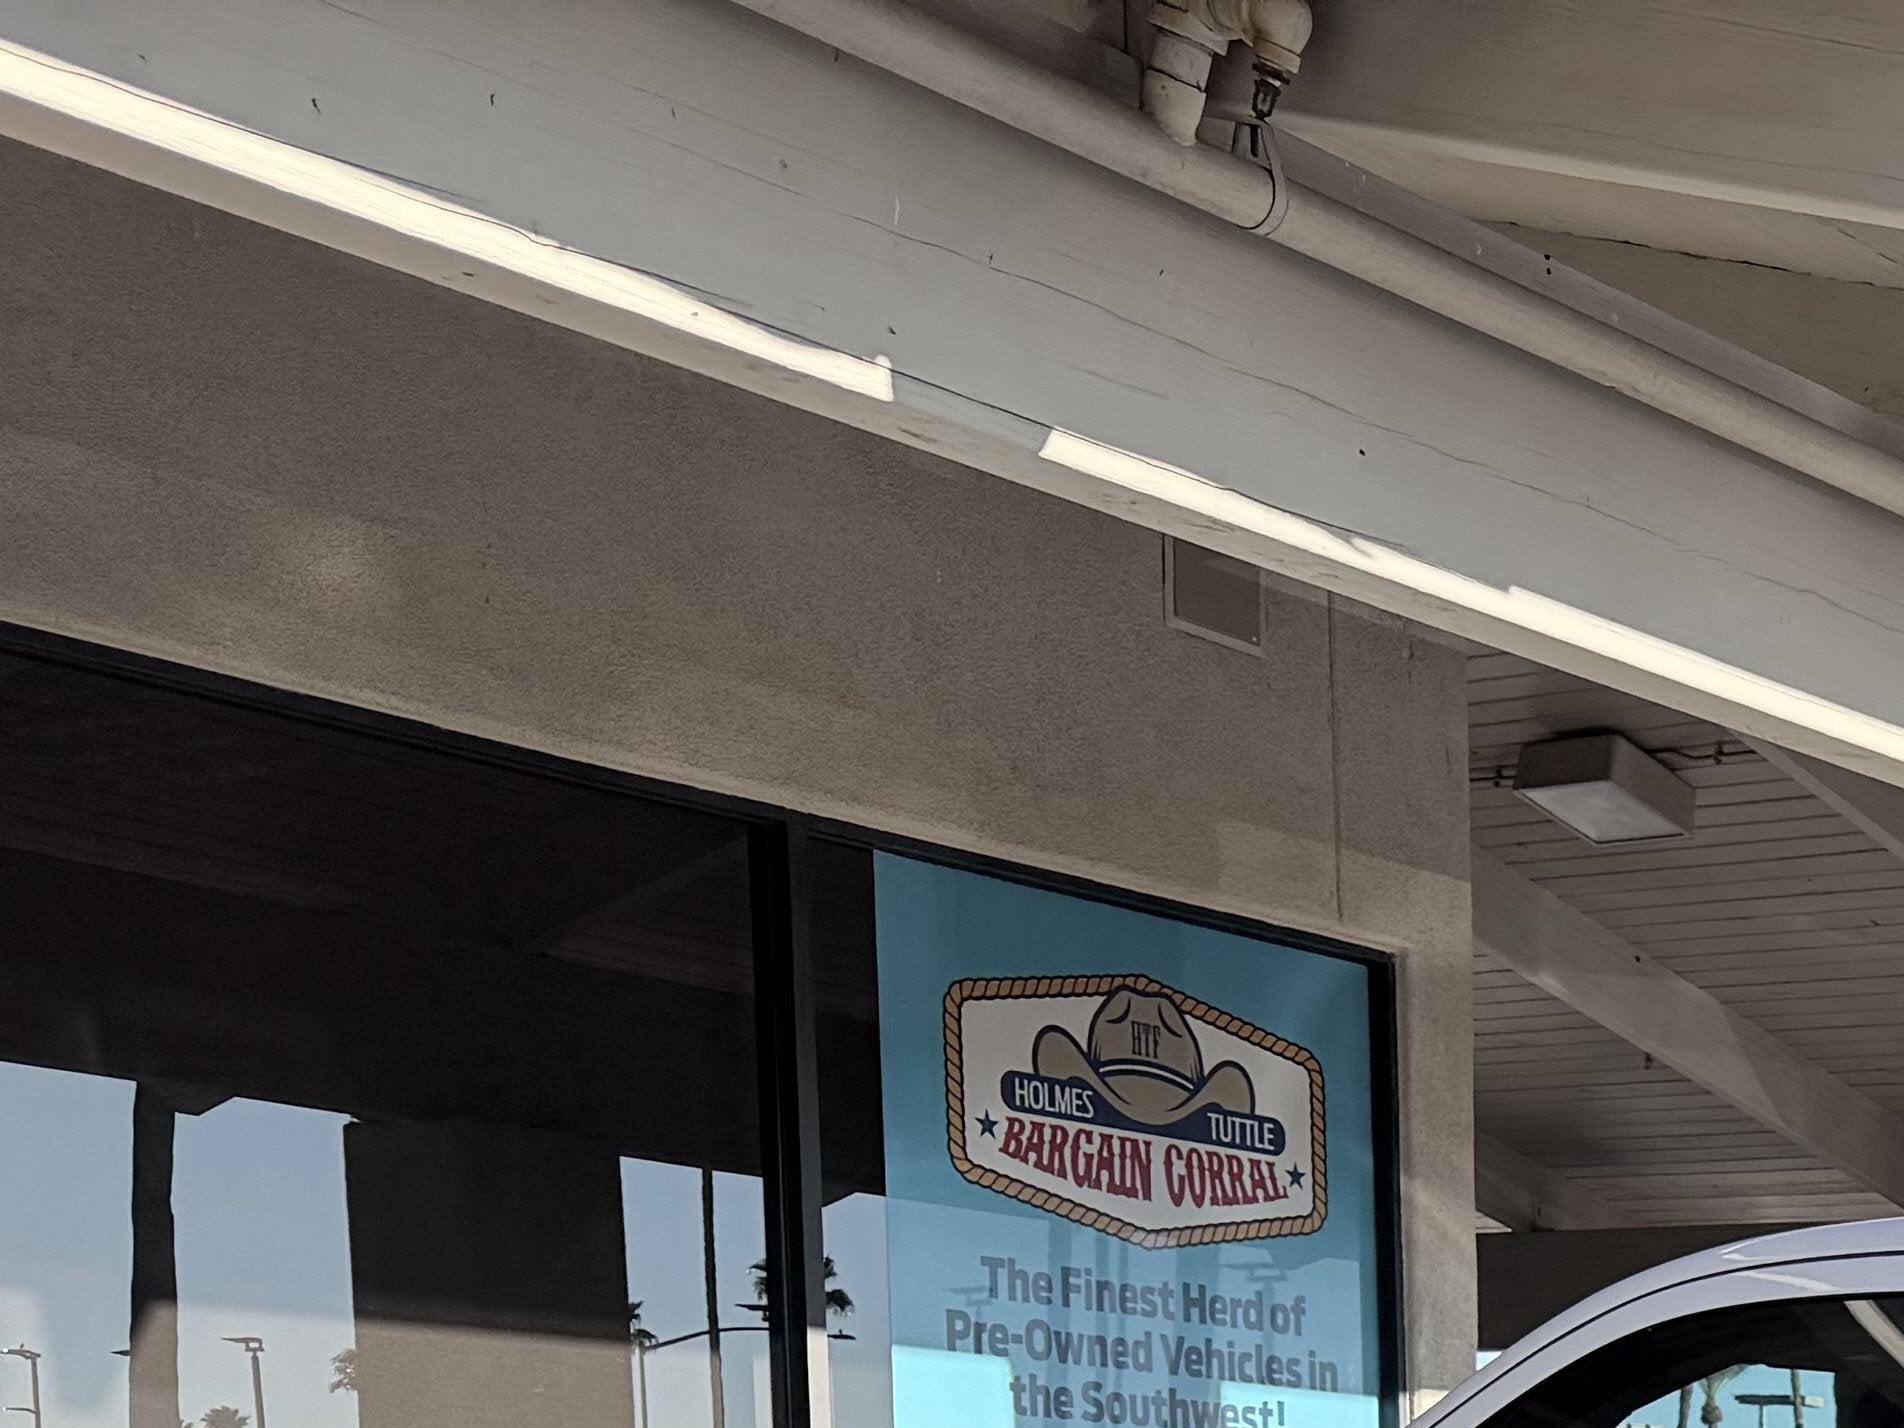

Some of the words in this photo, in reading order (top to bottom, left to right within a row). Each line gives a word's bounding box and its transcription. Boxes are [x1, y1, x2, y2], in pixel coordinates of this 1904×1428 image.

[1131, 1020, 1162, 1060] HTF
[1014, 1077, 1095, 1118] HOLMES
[1206, 1112, 1276, 1151] TUTTLE
[998, 1116, 1152, 1202] BARGAIN
[1163, 1144, 1289, 1208] CORRAL
[980, 1256, 1053, 1301] The
[1061, 1267, 1175, 1320] Finest
[1183, 1283, 1264, 1330] Herd
[1270, 1295, 1307, 1337] of
[945, 1308, 1153, 1374] Pre-Owned
[1160, 1333, 1300, 1388] Vehicles
[1308, 1351, 1338, 1393] in
[1009, 1374, 1073, 1421] the
